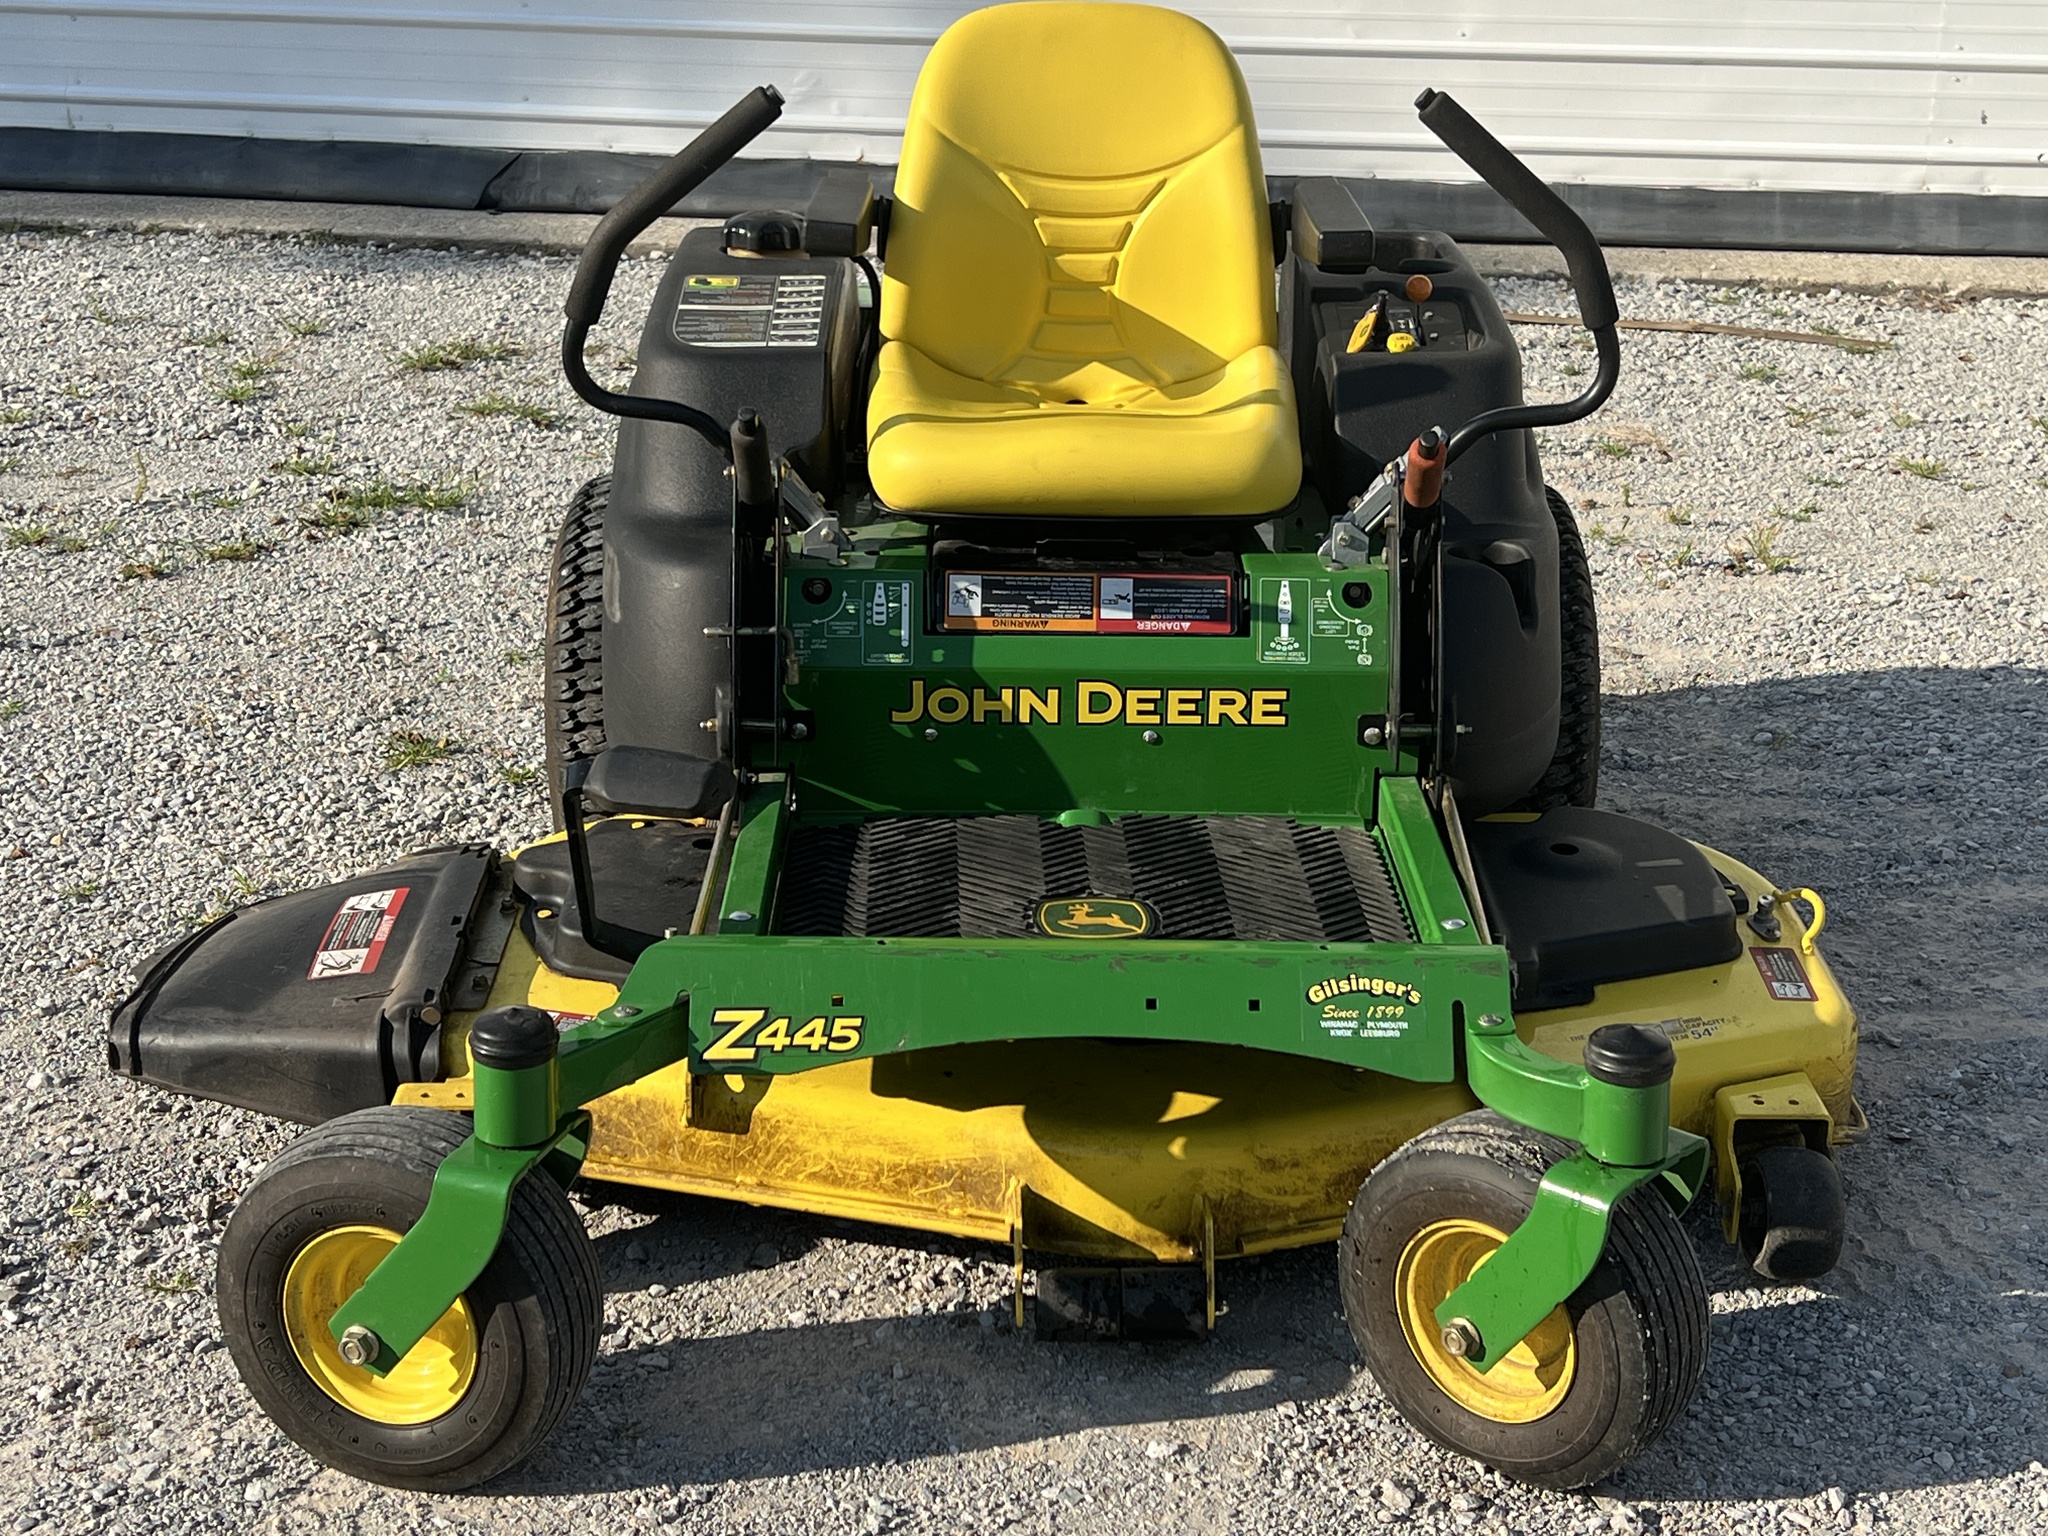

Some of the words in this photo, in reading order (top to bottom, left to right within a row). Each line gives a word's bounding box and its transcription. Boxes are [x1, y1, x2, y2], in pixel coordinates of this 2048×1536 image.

[992, 619, 1041, 629] WARNING
[1137, 621, 1180, 631] DANGER
[890, 678, 1060, 725] JOHN
[1076, 680, 1290, 726] DEERE
[1307, 974, 1422, 1004] Gilsinger's
[1322, 1004, 1360, 1018] Since
[1366, 1005, 1405, 1019] 1899
[1320, 1020, 1358, 1029] WINAMAC
[1366, 1020, 1409, 1030] PLYMOUTH
[1685, 1018, 1726, 1030] CAPACITY
[702, 1008, 864, 1062] Z445
[1330, 1029, 1353, 1038] KNOX
[1360, 1029, 1401, 1038] LEESBURG
[256, 1335, 345, 1441] KENDA
